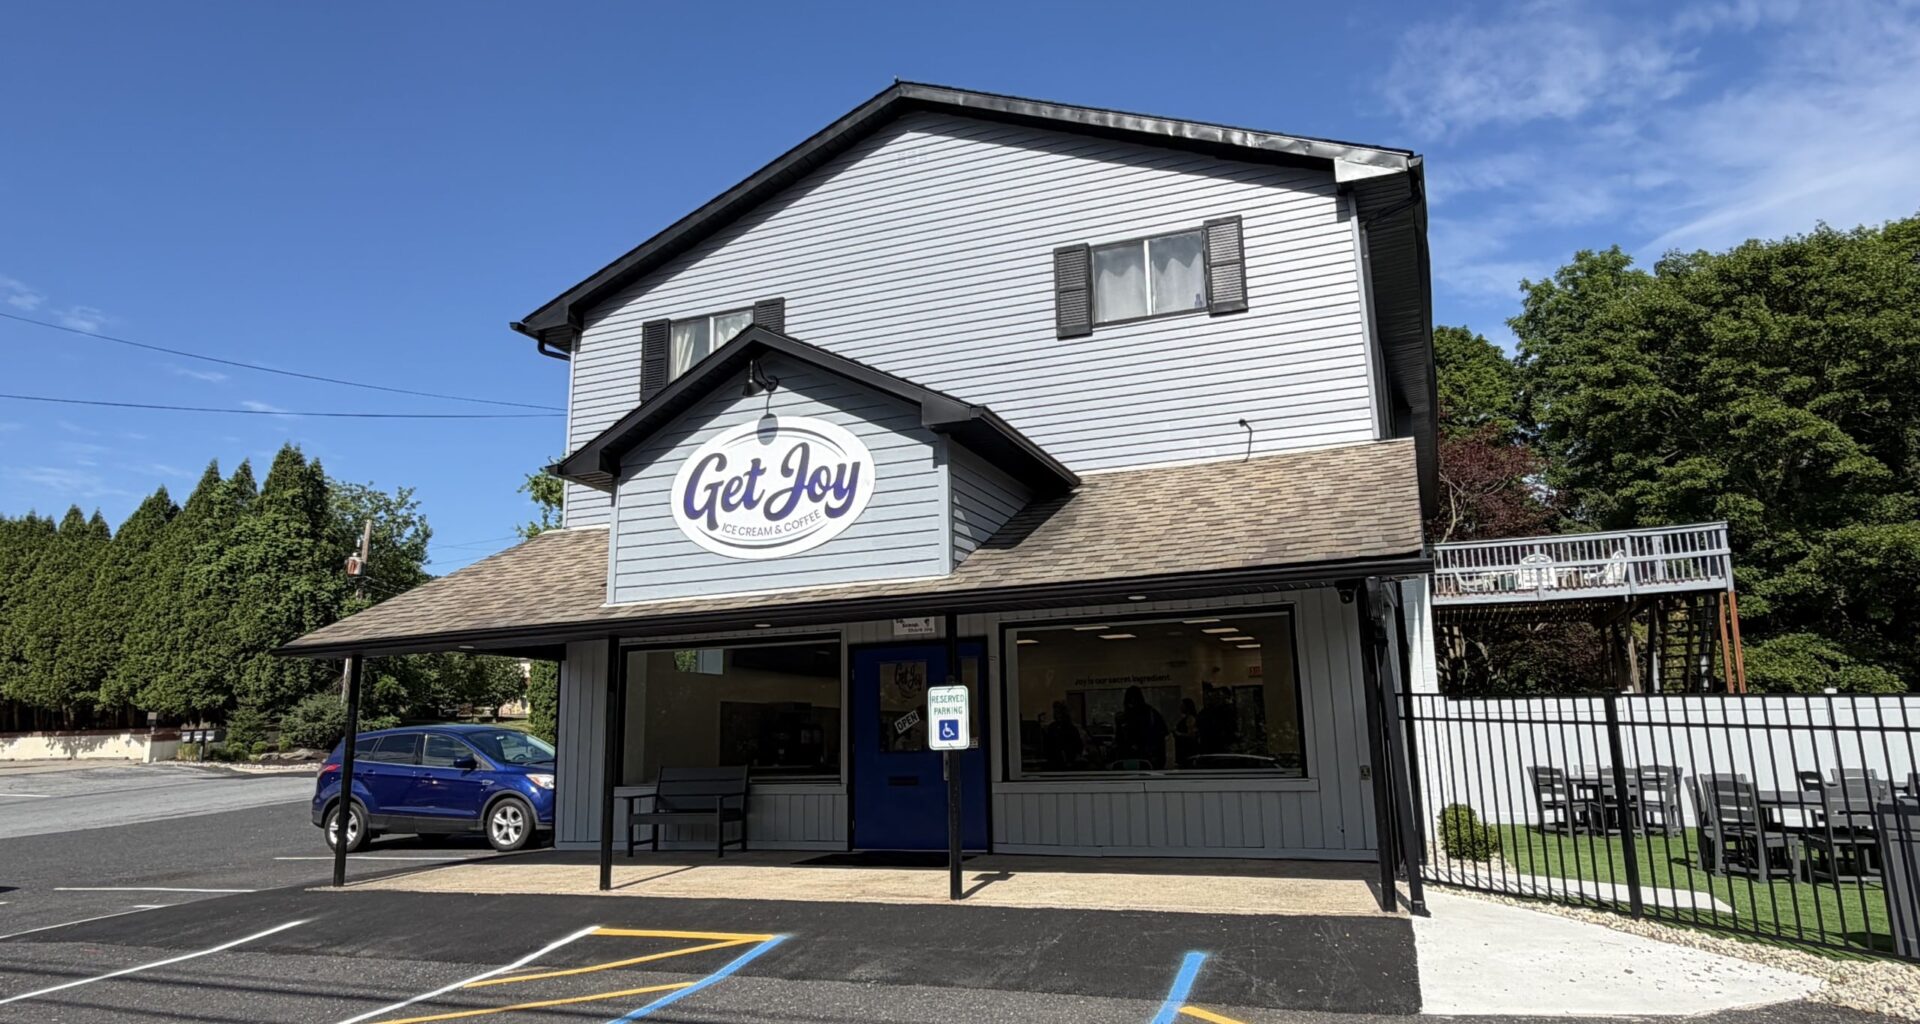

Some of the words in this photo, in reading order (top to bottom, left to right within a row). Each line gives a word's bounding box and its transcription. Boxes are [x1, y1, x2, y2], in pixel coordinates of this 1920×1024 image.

[683, 452, 767, 531] Get
[763, 442, 861, 522] Joy
[721, 523, 737, 535] ICE
[738, 526, 773, 537] CREAM
[774, 524, 783, 534] &
[784, 509, 821, 532] COFFEE
[894, 663, 908, 685] Get
[908, 664, 923, 692] Joy
[931, 694, 965, 704] RESERVED
[896, 712, 918, 731] OPEN
[933, 706, 963, 716] PARKING
